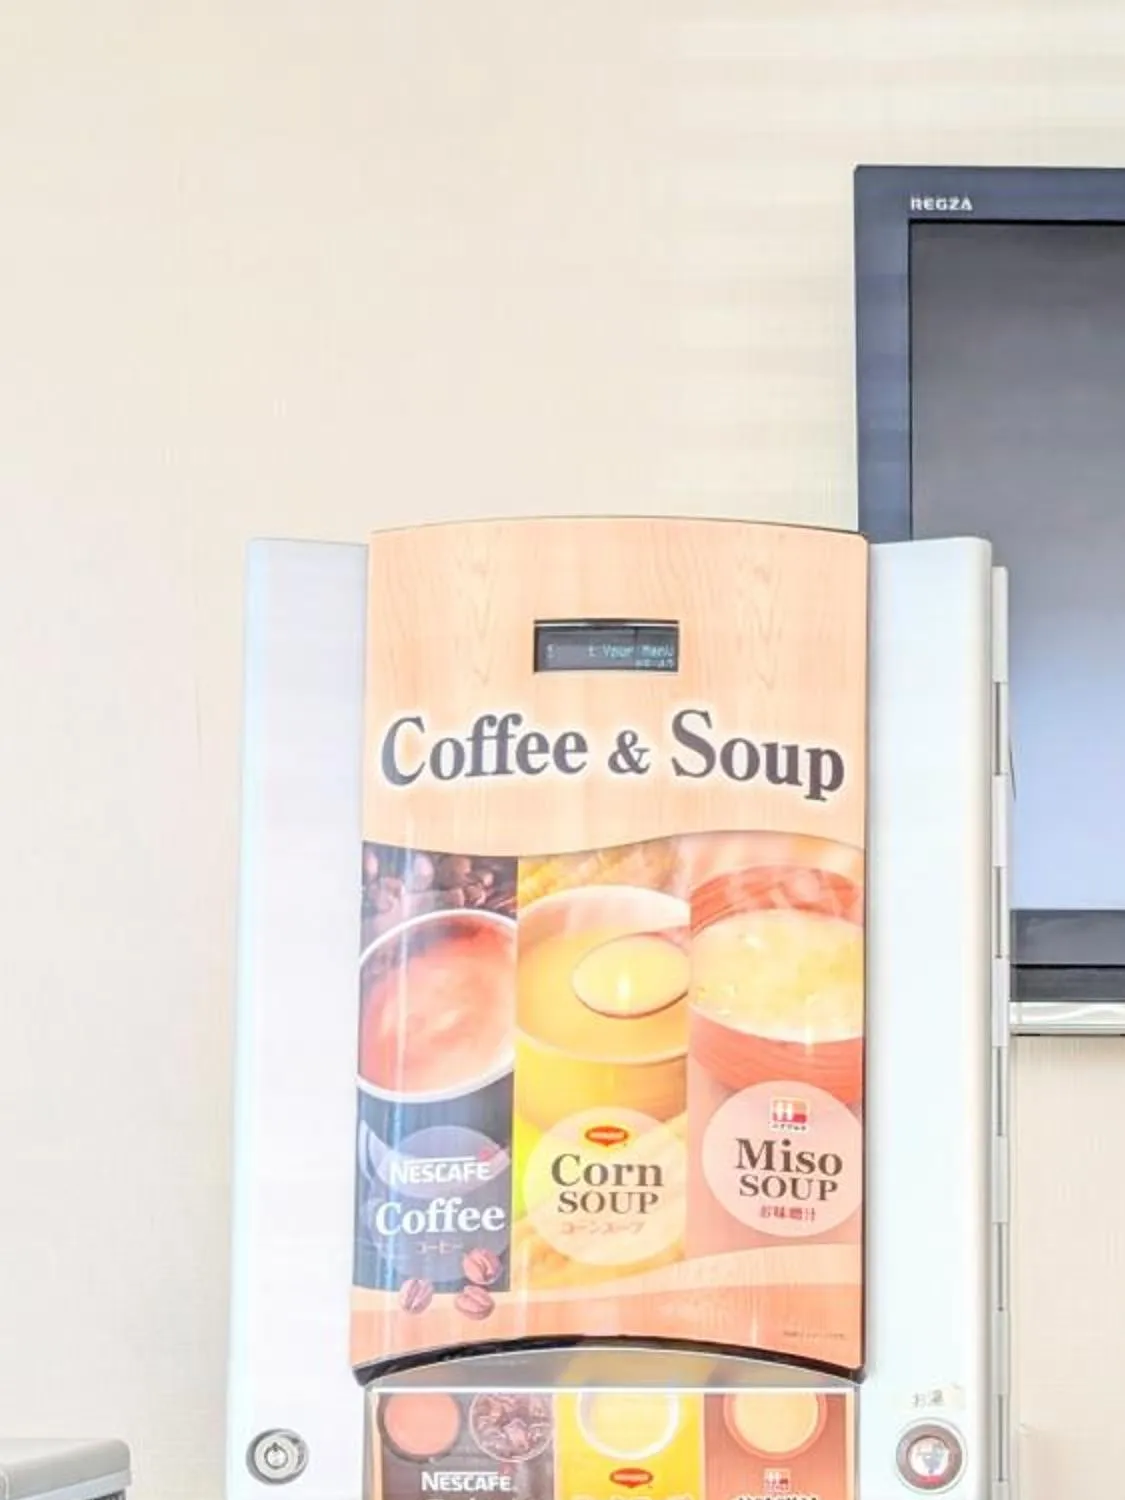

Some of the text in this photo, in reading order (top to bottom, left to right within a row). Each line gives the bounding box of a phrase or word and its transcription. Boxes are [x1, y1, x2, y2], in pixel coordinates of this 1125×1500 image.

[910, 196, 973, 211] REGZA
[381, 708, 845, 803] Coffee & Soup
[551, 1153, 664, 1187] Corn
[735, 1138, 843, 1176] Miso
[557, 1189, 659, 1214] SOUP
[739, 1173, 838, 1201] SOUP
[375, 1197, 506, 1236] Coffee
